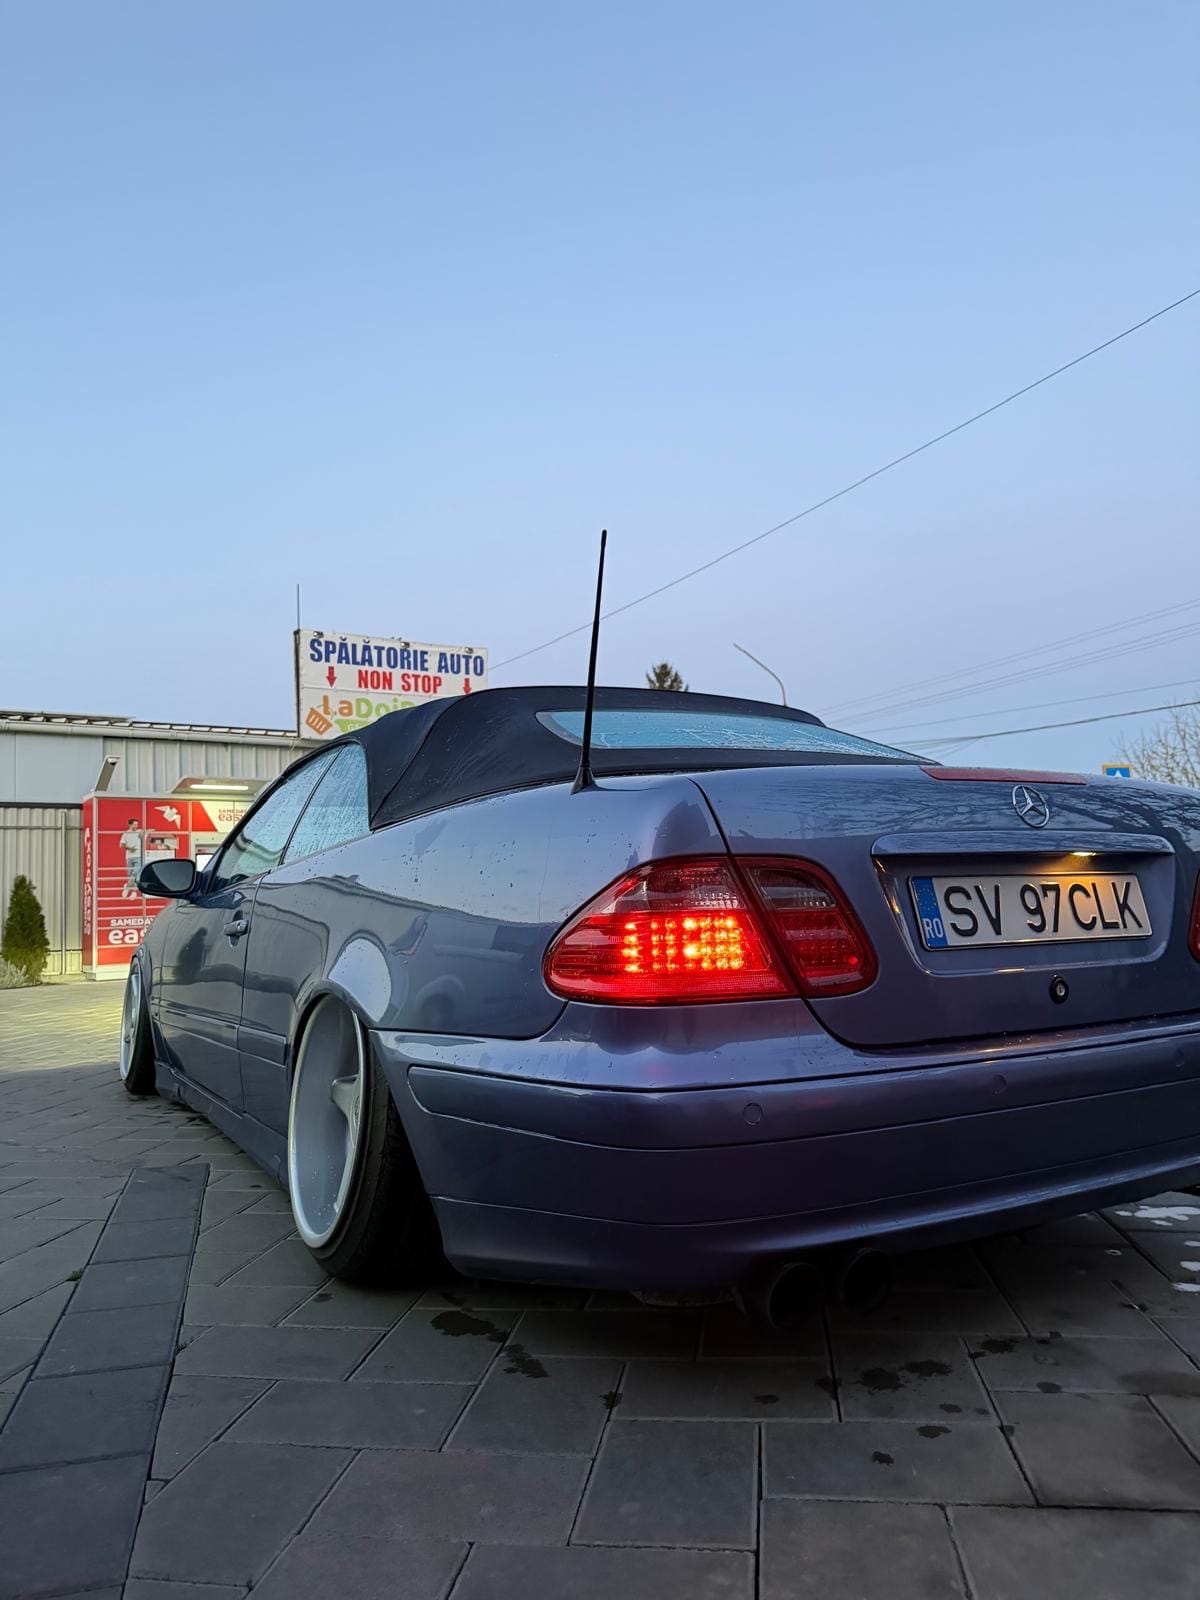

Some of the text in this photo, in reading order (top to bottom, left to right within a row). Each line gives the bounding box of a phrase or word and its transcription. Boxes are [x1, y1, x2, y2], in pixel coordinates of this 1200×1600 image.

[309, 636, 484, 676] SPĂLĂTORIE AUTO
[357, 669, 442, 694] NON STOP
[944, 885, 1002, 937] SV
[923, 917, 944, 939] RO
